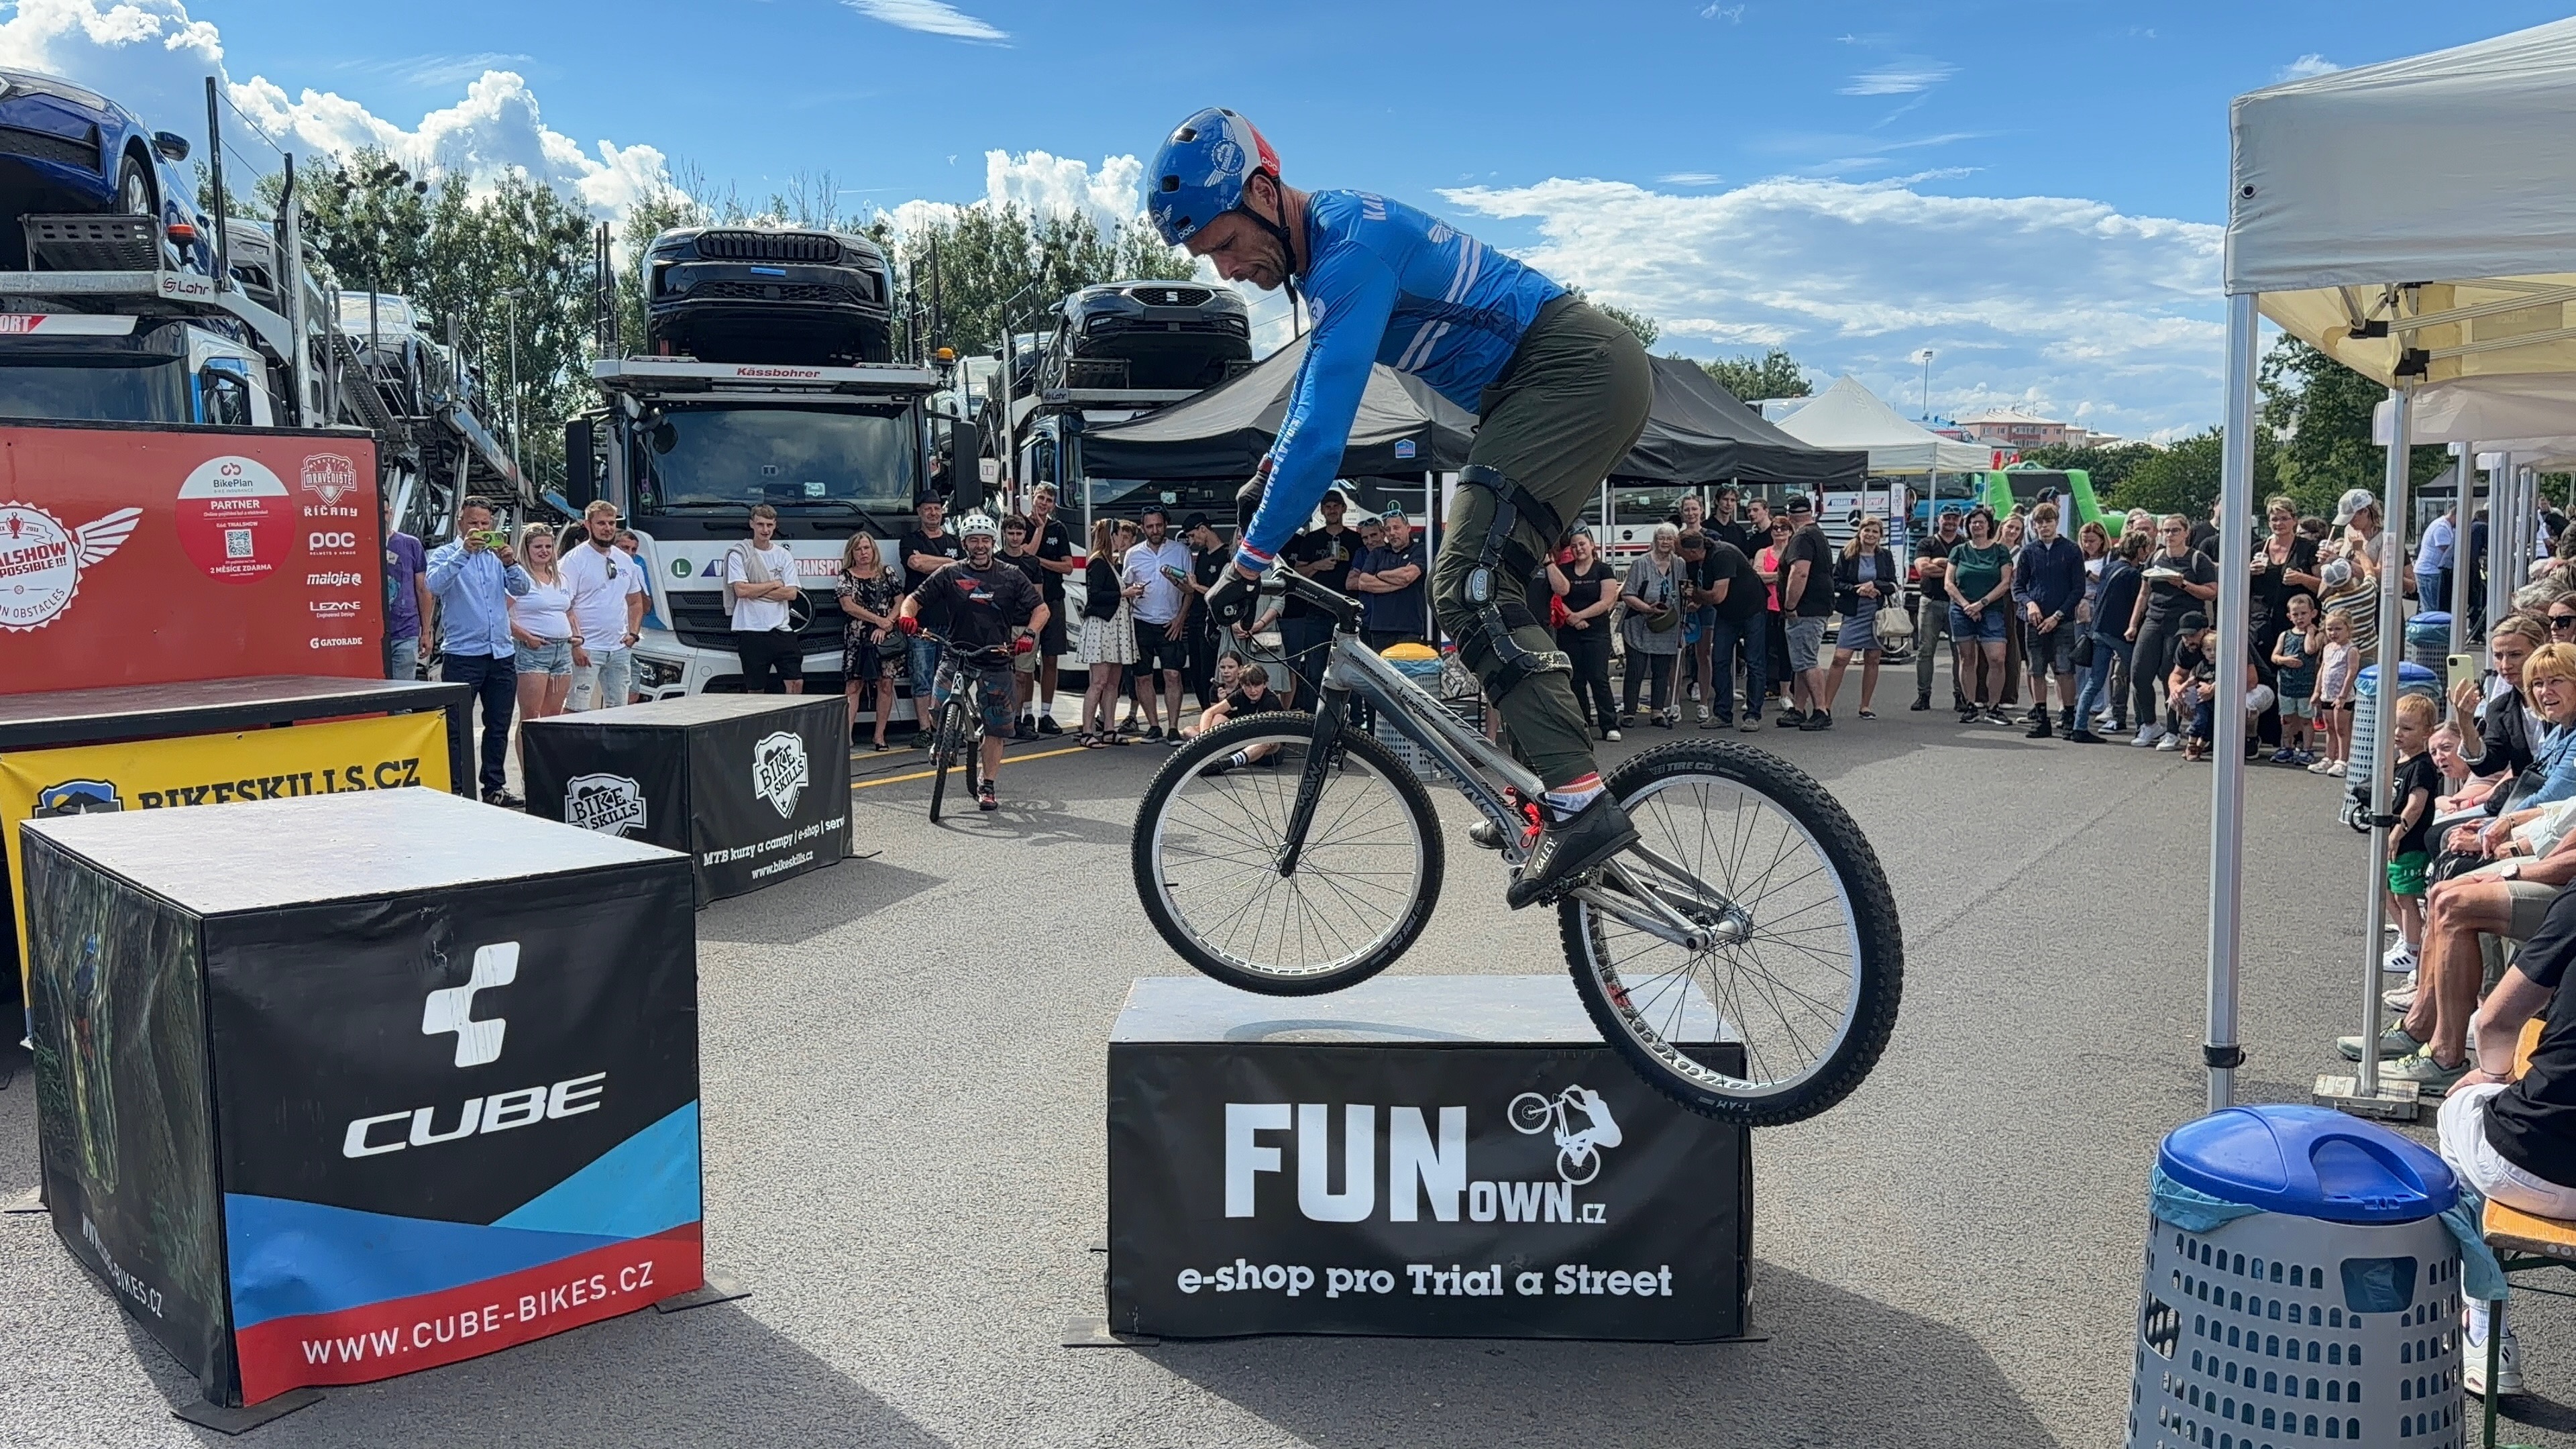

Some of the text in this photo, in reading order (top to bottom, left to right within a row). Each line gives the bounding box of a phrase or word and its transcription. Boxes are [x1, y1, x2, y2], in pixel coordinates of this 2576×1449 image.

[178, 280, 209, 295] Lohr
[737, 368, 820, 378] Kässbohrer
[213, 479, 253, 488] BikePlan
[211, 500, 260, 510] PARTNER
[215, 565, 241, 573] MĚSÍCE
[307, 571, 350, 586] maloja
[677, 562, 686, 575] L
[13, 588, 64, 618] OBSTACLES
[310, 601, 361, 610] LEZYNE
[321, 637, 363, 646] GATORADE
[759, 745, 796, 790] BIKE
[1667, 762, 1695, 771] TIRE
[775, 759, 804, 796] SKILLS
[573, 787, 627, 820] BIKE
[590, 803, 639, 830] SKILLS
[703, 850, 729, 866] MTB
[731, 845, 755, 861] kurzy
[757, 844, 764, 853] a
[765, 833, 793, 851] campy
[798, 824, 819, 838] e-shop
[751, 850, 814, 879] www.bikeskills.cz
[343, 1071, 606, 1158] CUBE
[1177, 1258, 1673, 1298] e-shop pro Trial a Street
[302, 1261, 655, 1364] WWW.CUBE-BIKES.CZ
